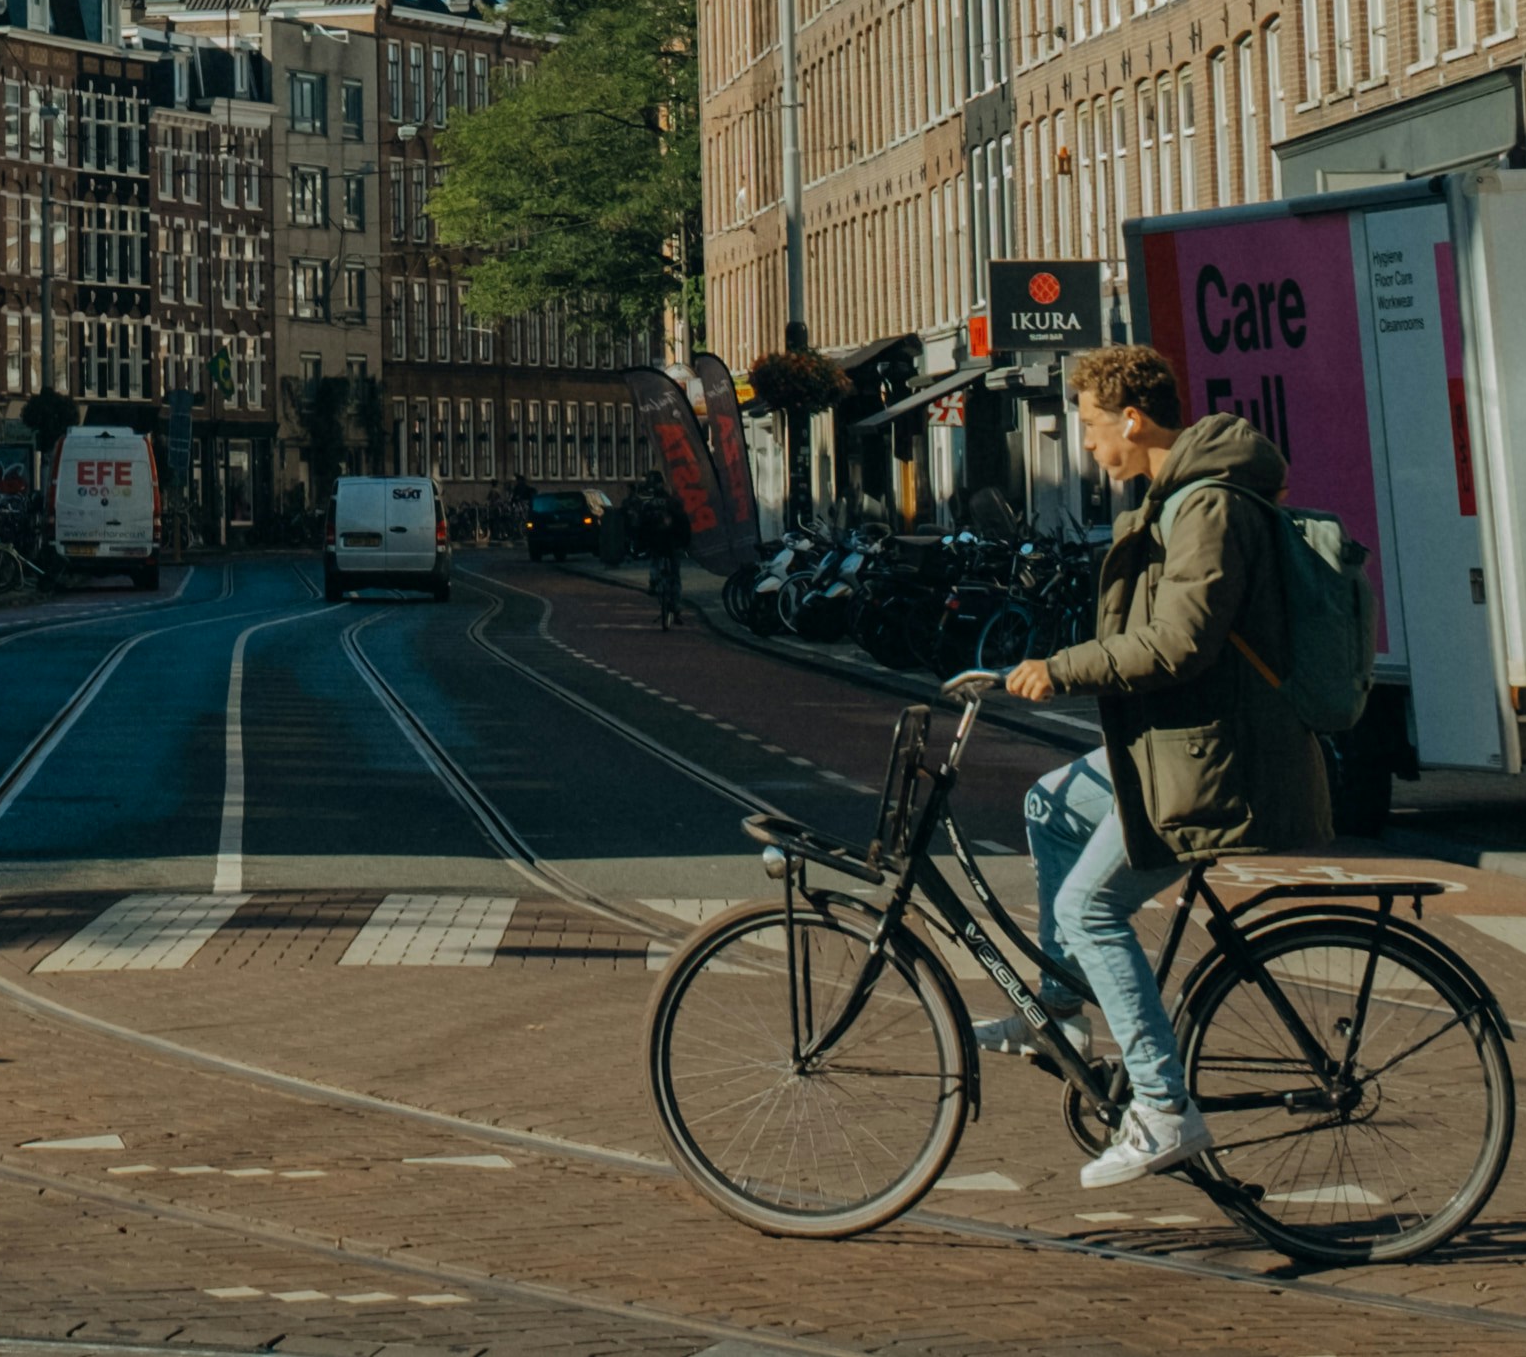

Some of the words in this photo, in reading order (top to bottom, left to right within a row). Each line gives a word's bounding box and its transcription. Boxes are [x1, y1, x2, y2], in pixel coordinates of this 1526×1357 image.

[1372, 251, 1403, 267] Hygiene
[1374, 273, 1393, 287] Floor
[1395, 271, 1413, 285] Care
[1197, 264, 1307, 354] Care
[1011, 312, 1082, 330] IKURA
[78, 461, 132, 486] EFE
[966, 922, 1048, 1029] VOGUE
